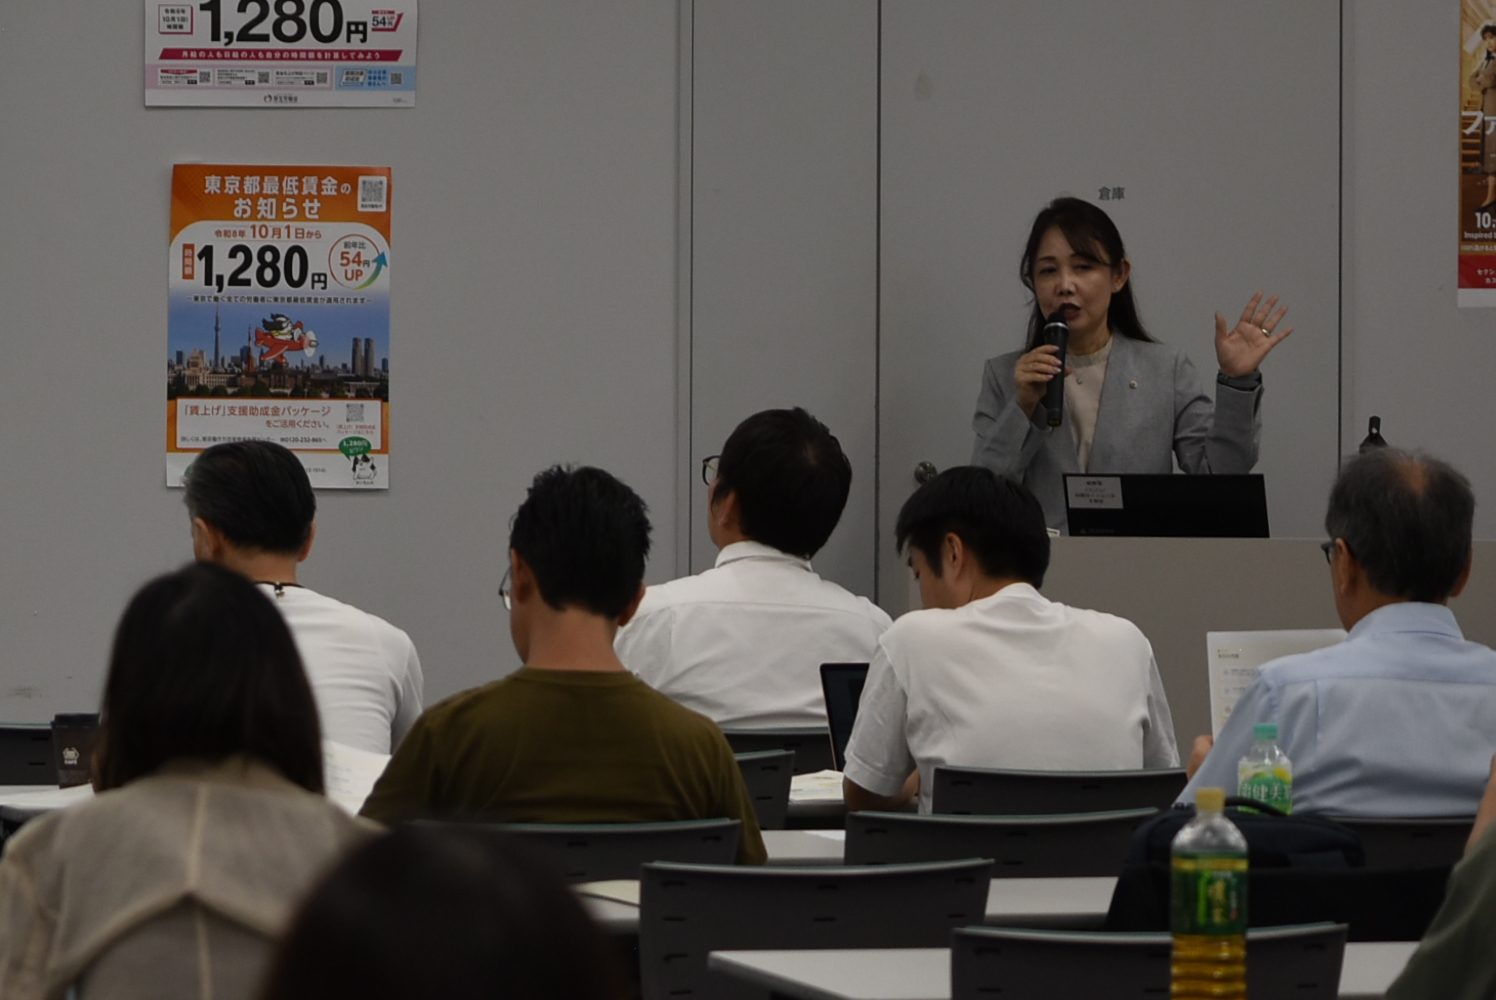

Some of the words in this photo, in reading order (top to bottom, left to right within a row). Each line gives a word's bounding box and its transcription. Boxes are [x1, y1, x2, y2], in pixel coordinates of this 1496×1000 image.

[203, 175, 352, 196] 東京都最低賃金の
[1098, 186, 1125, 200] 倉庫
[233, 197, 321, 220] お知らせ
[1464, 231, 1493, 240] Inspired
[343, 241, 367, 250] 前年比
[339, 251, 371, 267] 54円
[197, 243, 328, 293] 1,280円
[1476, 268, 1496, 276] セクシ
[344, 270, 364, 282] UP
[184, 405, 332, 417] 「賃上げ」支援助成金パッケージ
[265, 419, 331, 429] をご活用ください。
